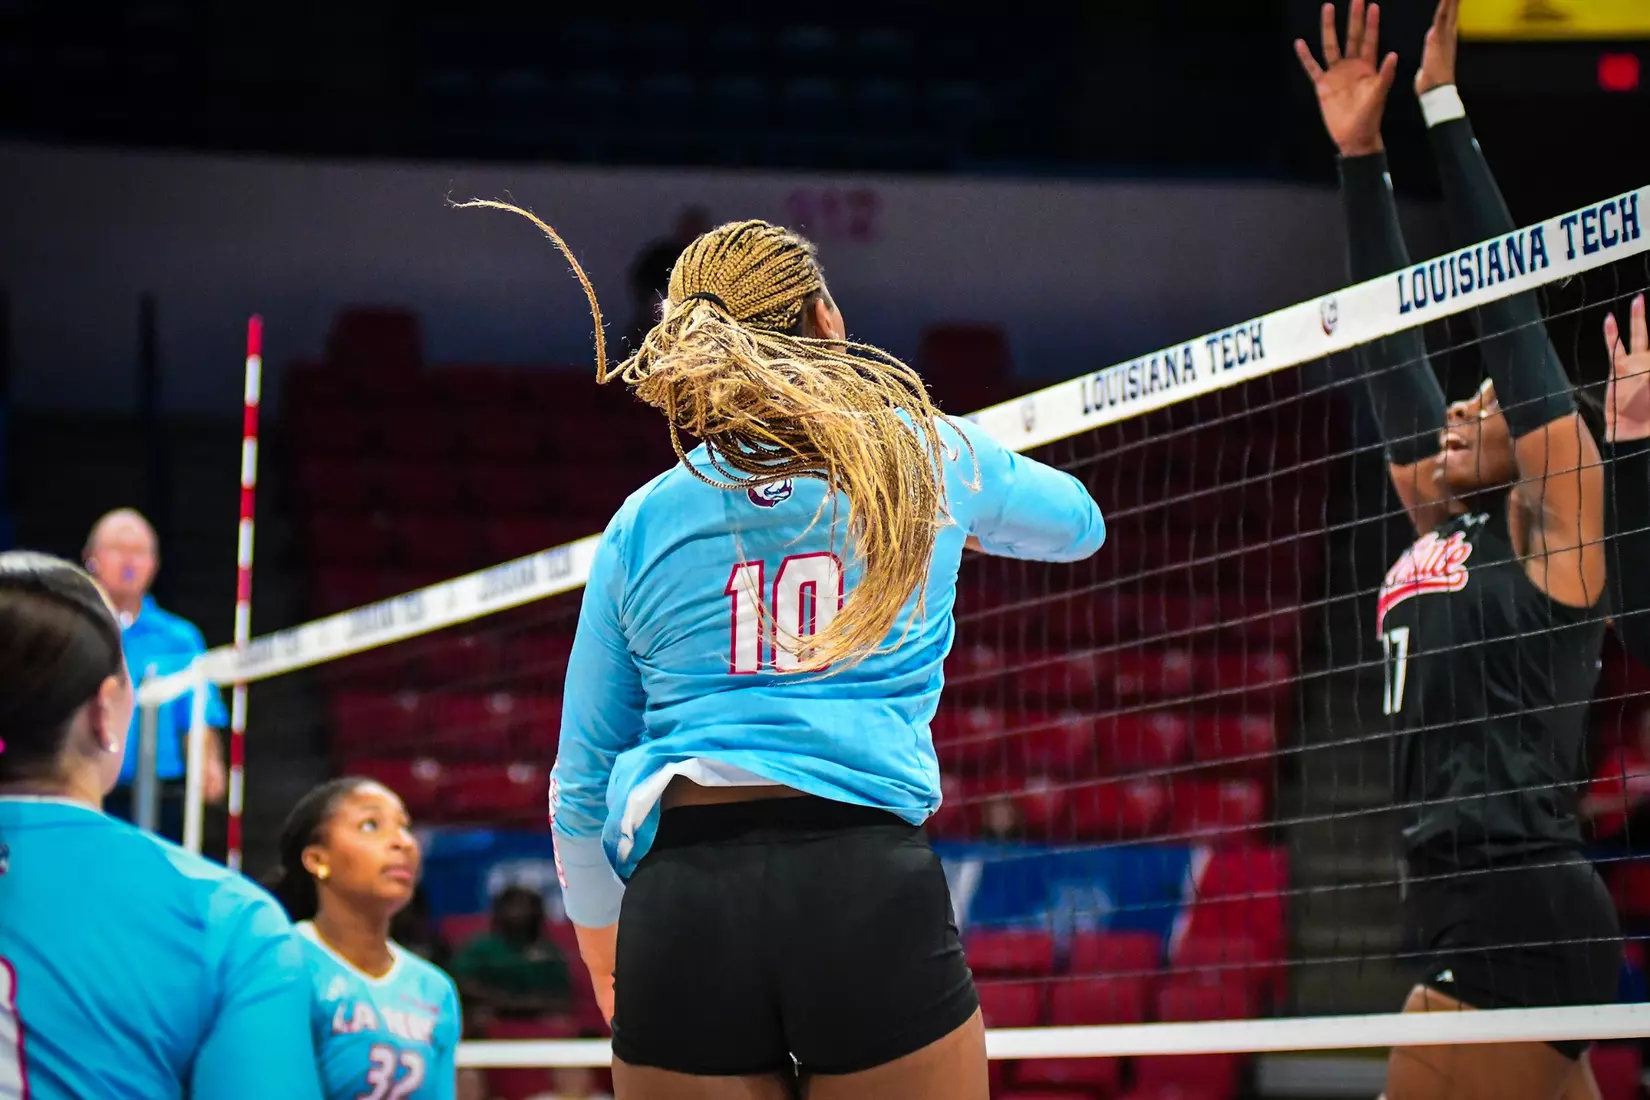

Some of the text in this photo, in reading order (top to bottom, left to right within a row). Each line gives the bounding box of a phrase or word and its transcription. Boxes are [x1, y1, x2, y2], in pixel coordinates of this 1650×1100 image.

[1397, 193, 1641, 315] LOUISIANA TECH
[1080, 321, 1266, 416] LOUISIANA TECH
[723, 551, 845, 675] 10
[355, 1042, 425, 1100] 32
